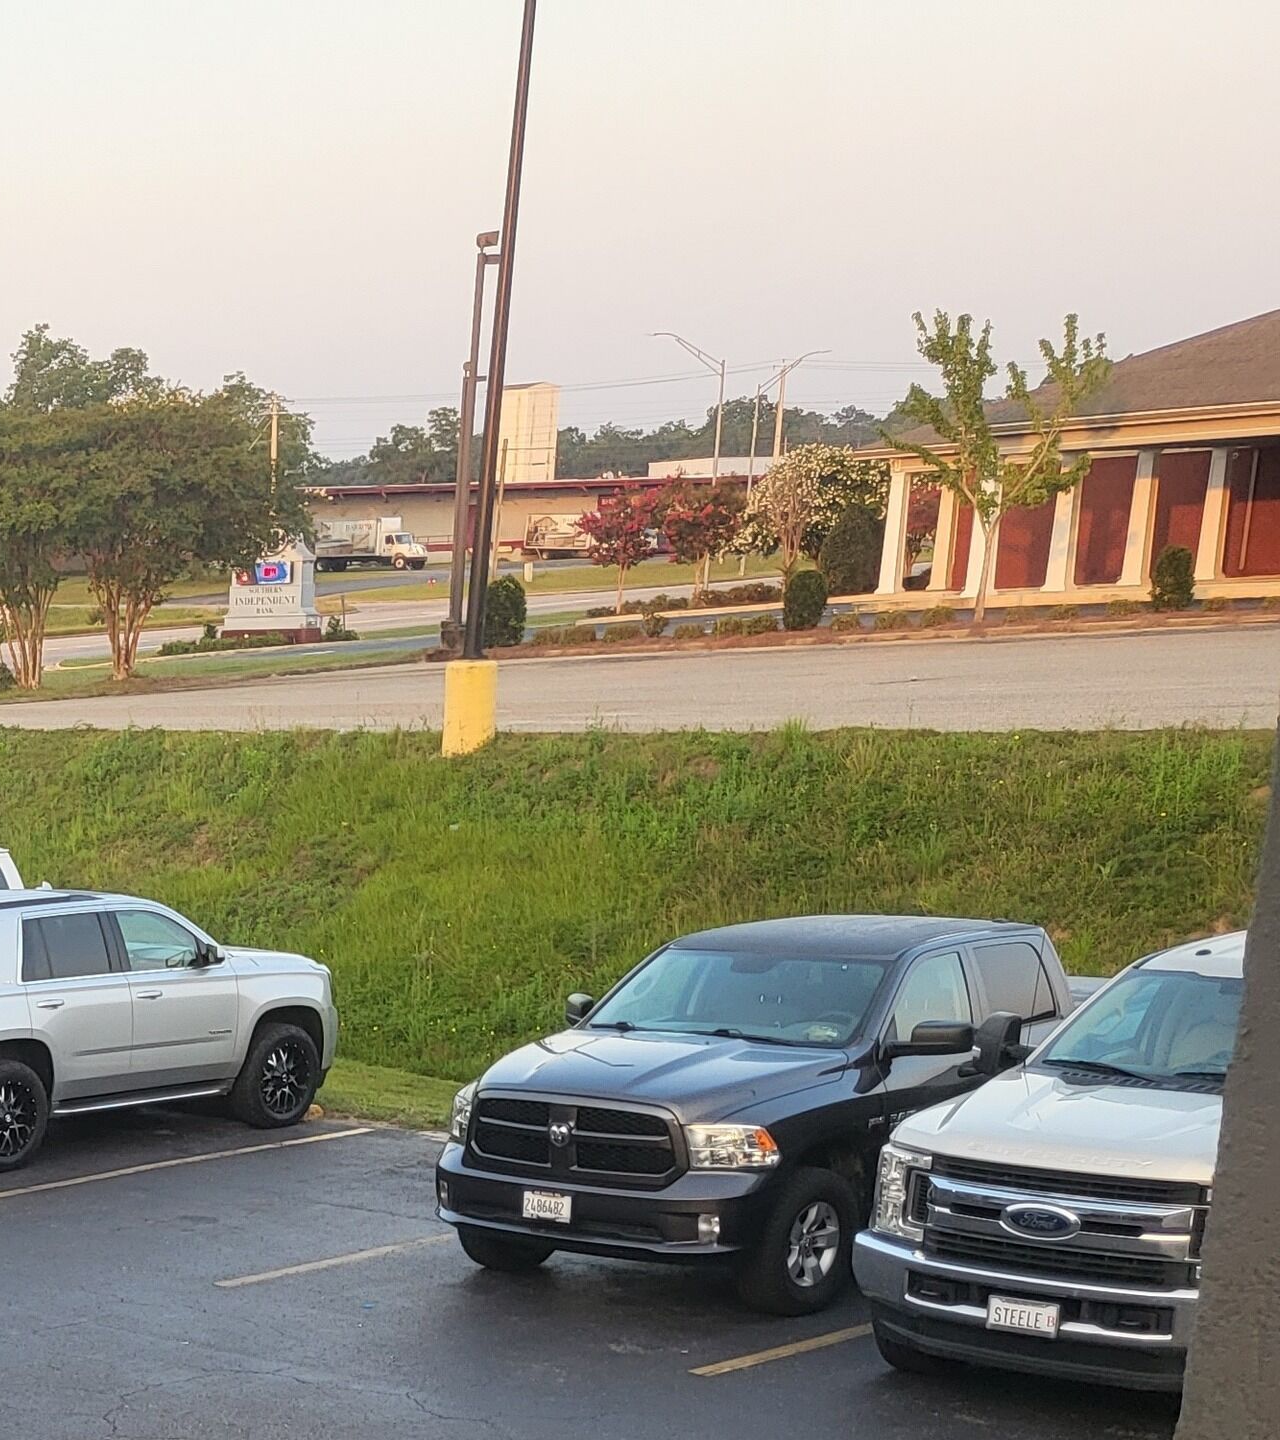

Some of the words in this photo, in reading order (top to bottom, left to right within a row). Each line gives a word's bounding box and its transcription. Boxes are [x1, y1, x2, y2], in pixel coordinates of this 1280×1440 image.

[235, 595, 296, 606] INDEPENDENT
[525, 1198, 564, 1216] 2486482
[1019, 1212, 1057, 1232] Ford
[993, 1306, 1043, 1329] STEELE
